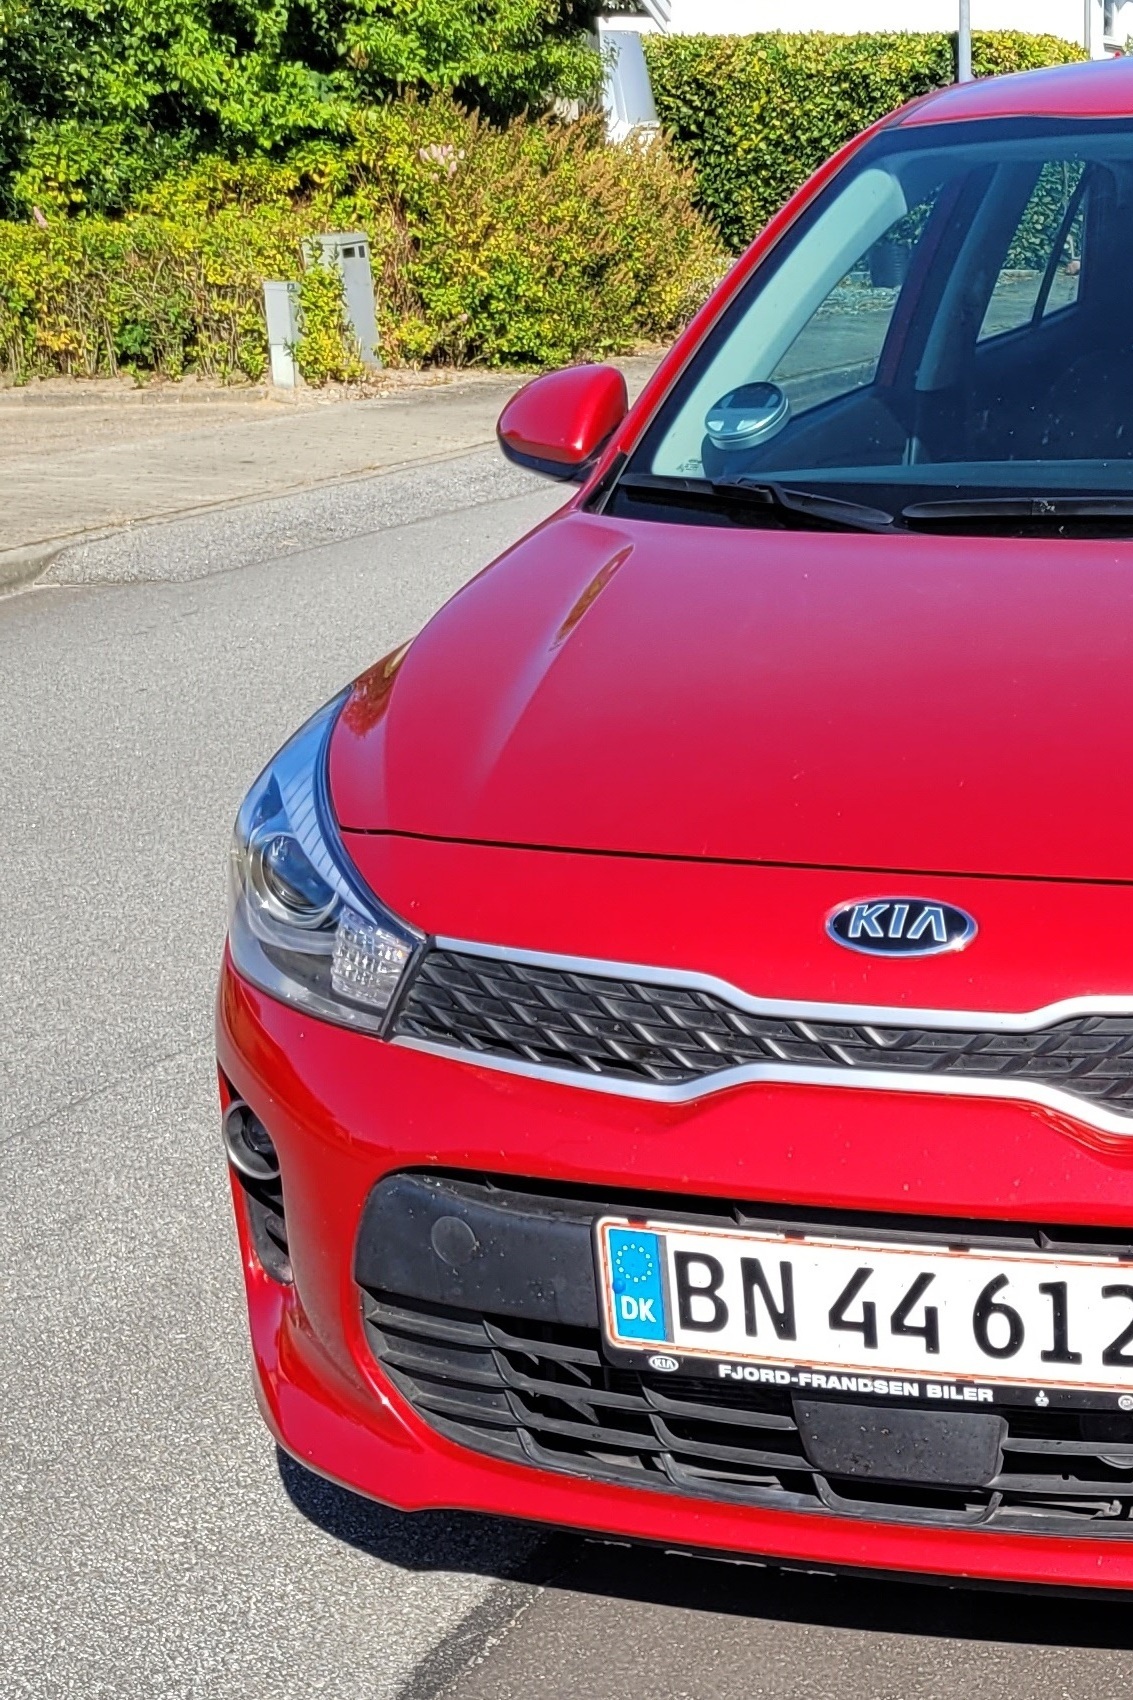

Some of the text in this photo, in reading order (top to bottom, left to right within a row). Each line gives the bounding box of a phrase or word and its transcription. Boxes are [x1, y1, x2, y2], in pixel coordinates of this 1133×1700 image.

[847, 903, 948, 942] KIA
[620, 1295, 657, 1323] DK
[673, 1250, 797, 1341] BN
[828, 1266, 940, 1354] 44
[718, 1364, 995, 1403] FJORD-FRANDSEN BILER
